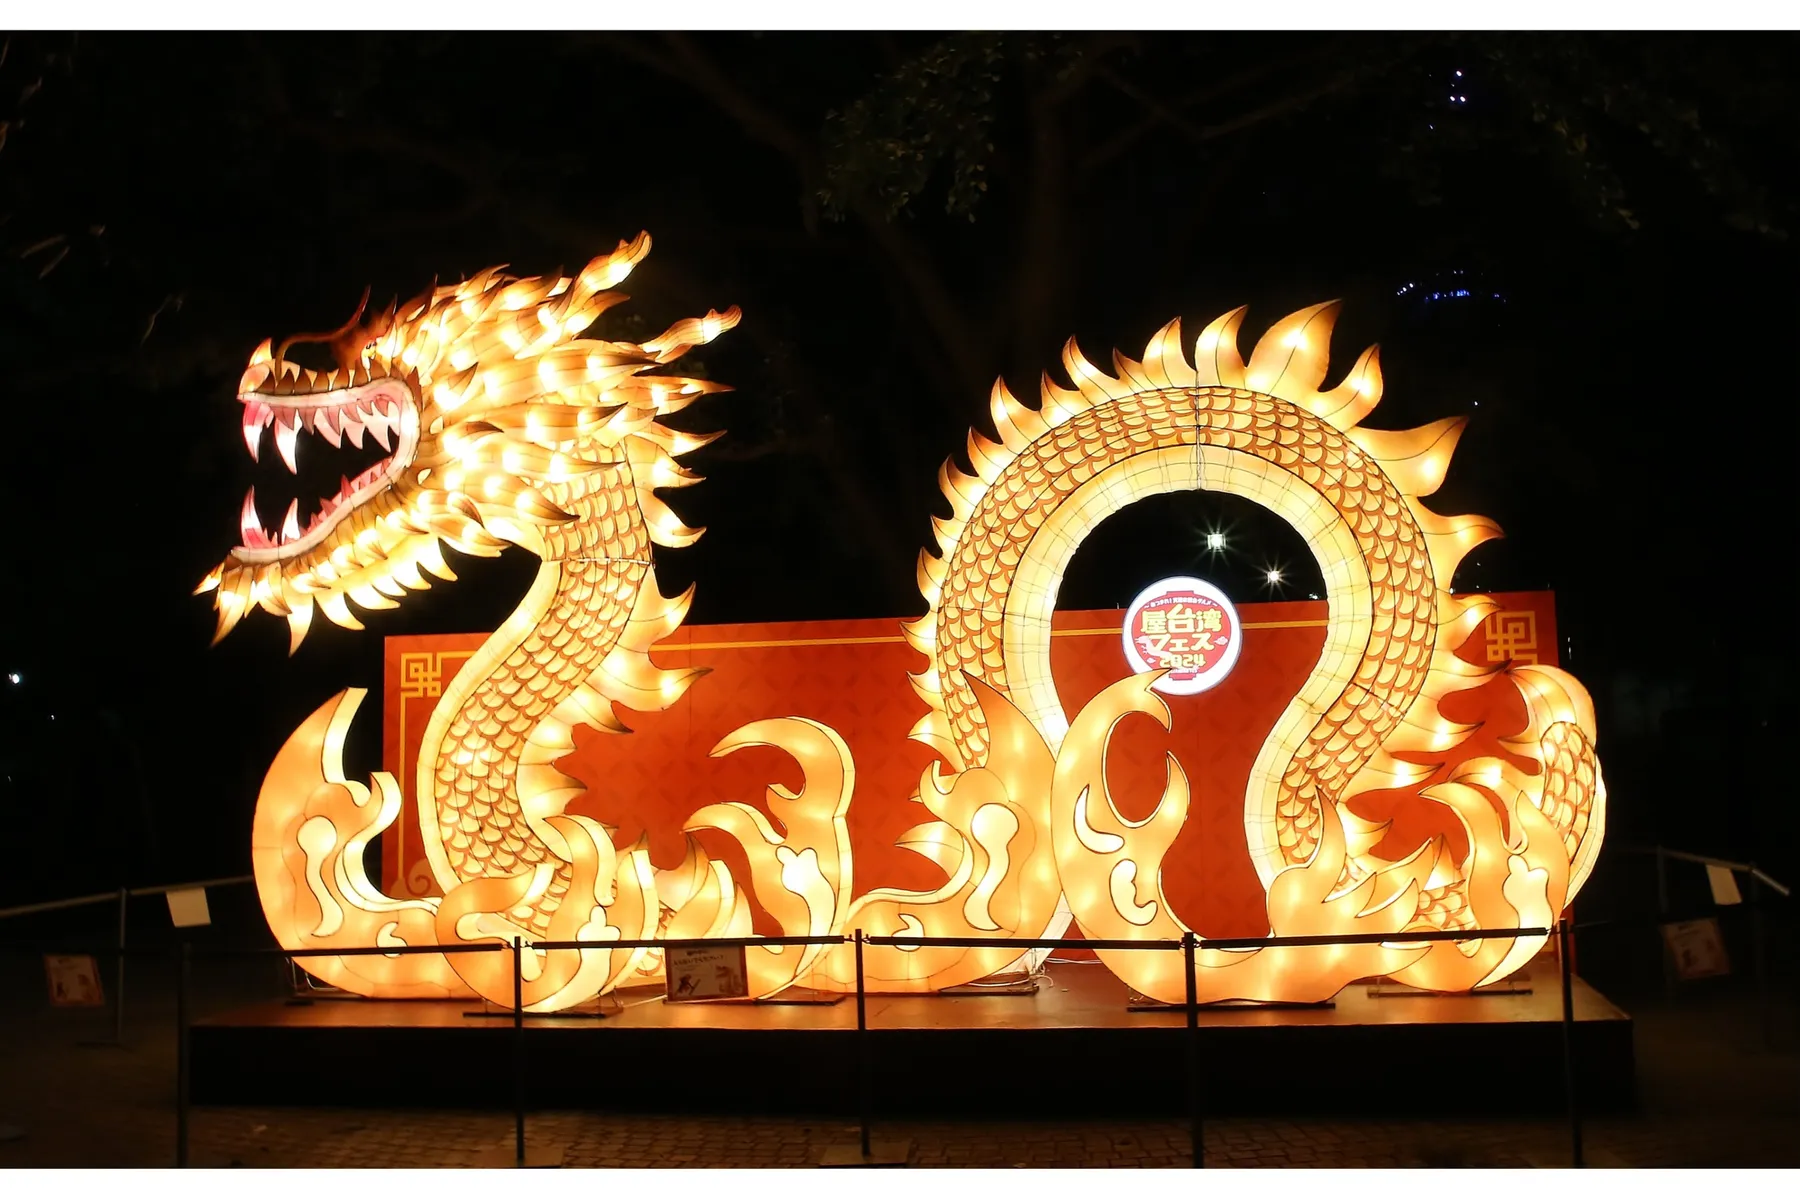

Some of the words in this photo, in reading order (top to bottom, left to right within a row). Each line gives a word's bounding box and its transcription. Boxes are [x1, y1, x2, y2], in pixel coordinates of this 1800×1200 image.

[1141, 604, 1221, 634] 屋台湾
[1149, 632, 1214, 651] フェス
[1160, 654, 1206, 667] 2024
